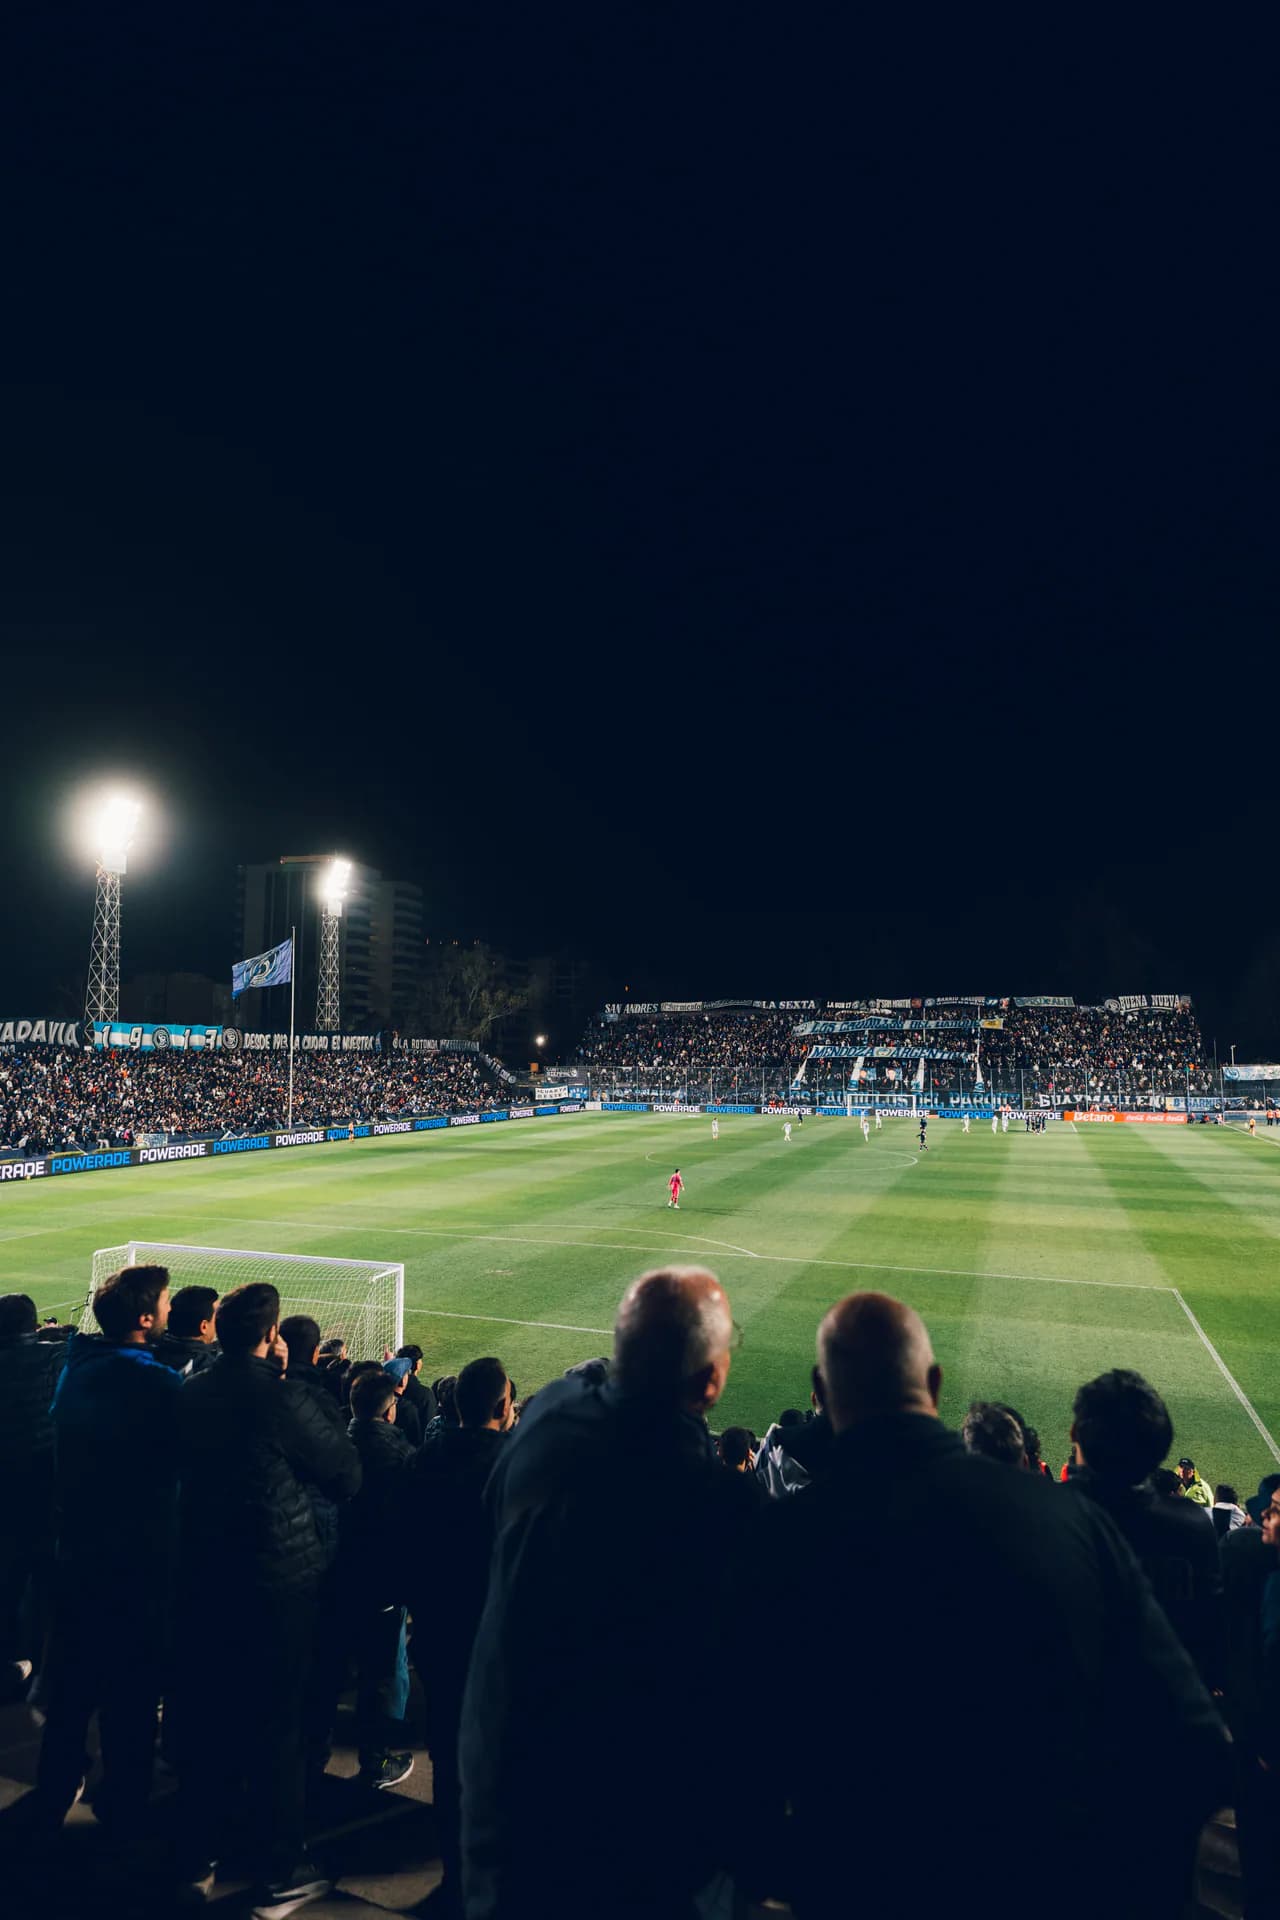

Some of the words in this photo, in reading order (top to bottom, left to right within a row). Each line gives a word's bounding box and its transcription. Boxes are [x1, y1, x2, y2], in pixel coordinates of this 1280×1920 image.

[605, 1004, 622, 1014] SAN
[623, 1003, 658, 1014] ANDRES
[762, 1001, 776, 1009] LA
[779, 1000, 815, 1009] SEXTA
[1119, 995, 1147, 1010] BUENA
[1151, 994, 1179, 1008] NUEVA
[811, 1022, 836, 1034] LOS
[244, 1033, 271, 1050] DESDE
[302, 1036, 329, 1050] CIUDAD
[811, 1046, 874, 1057] MENDOZA
[602, 1103, 648, 1111] POWERADE
[653, 1104, 700, 1113] POWERADE
[1002, 1112, 1062, 1120] POWDE
[1073, 1112, 1116, 1122] Betano
[0, 1161, 46, 1179] RADE
[51, 1151, 131, 1174] POWERADE
[140, 1143, 206, 1162] POWERADE
[213, 1136, 270, 1153] POWERADE
[275, 1131, 324, 1147] POWERADE
[327, 1126, 369, 1140] POWEADE
[373, 1122, 412, 1135] POWERADE
[415, 1117, 448, 1129] POWERADE
[450, 1114, 480, 1125] POWERADE
